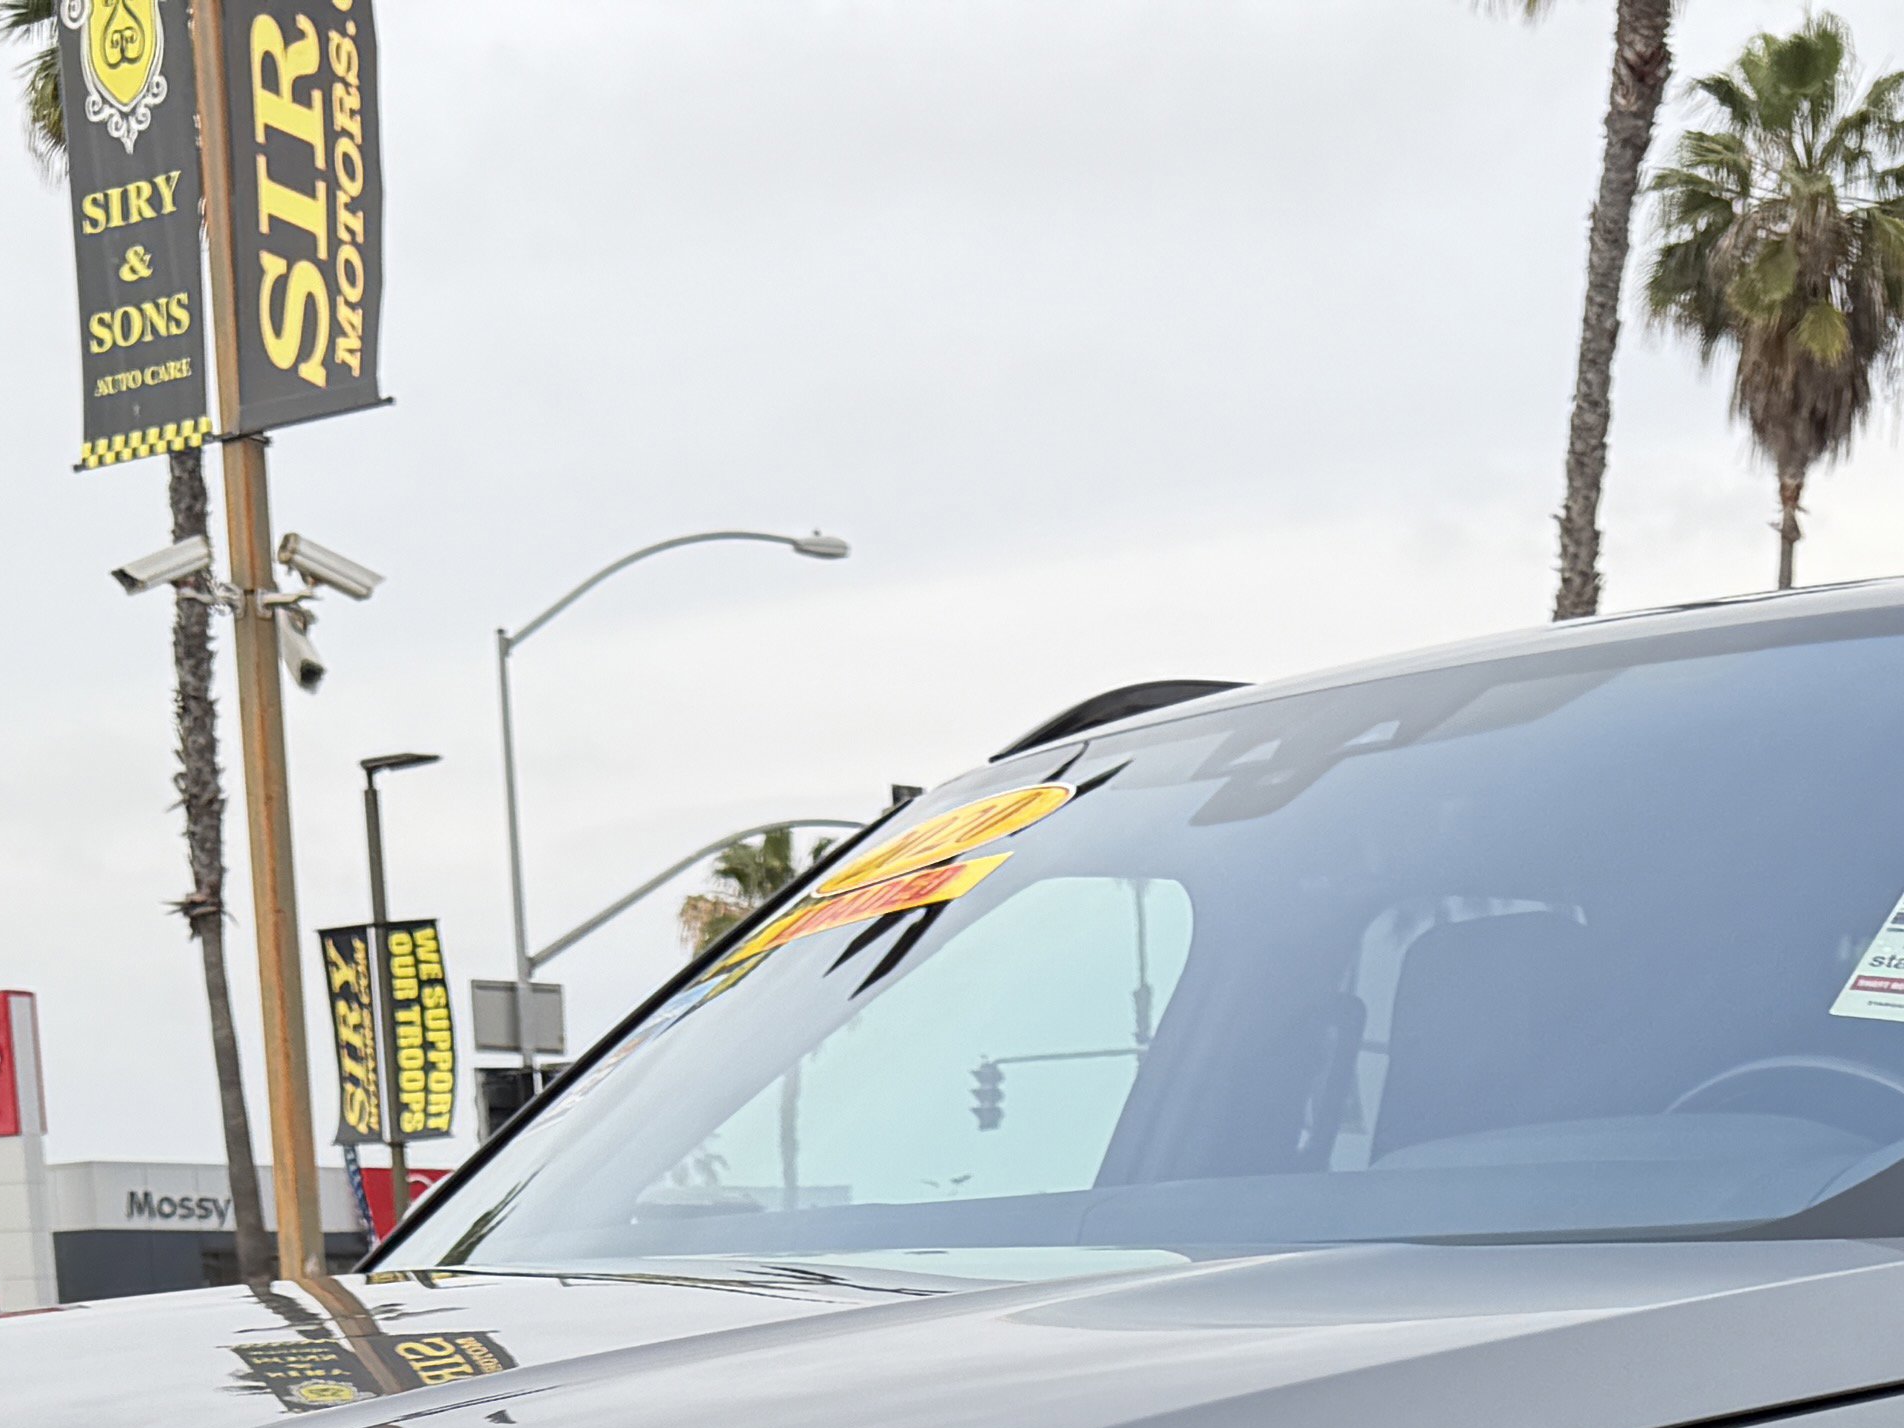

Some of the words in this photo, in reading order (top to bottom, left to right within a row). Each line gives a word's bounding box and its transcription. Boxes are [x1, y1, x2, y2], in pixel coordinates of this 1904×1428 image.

[82, 170, 182, 235] SIRY
[119, 245, 153, 282] &
[89, 292, 191, 354] SONS
[94, 368, 142, 397] AUTO
[144, 358, 192, 386] CARE
[388, 929, 418, 1001] OUR
[412, 926, 443, 981] WE
[395, 1003, 426, 1134] TROOPS
[421, 984, 454, 1132] SUPPORT
[126, 1190, 233, 1228] Mossy
